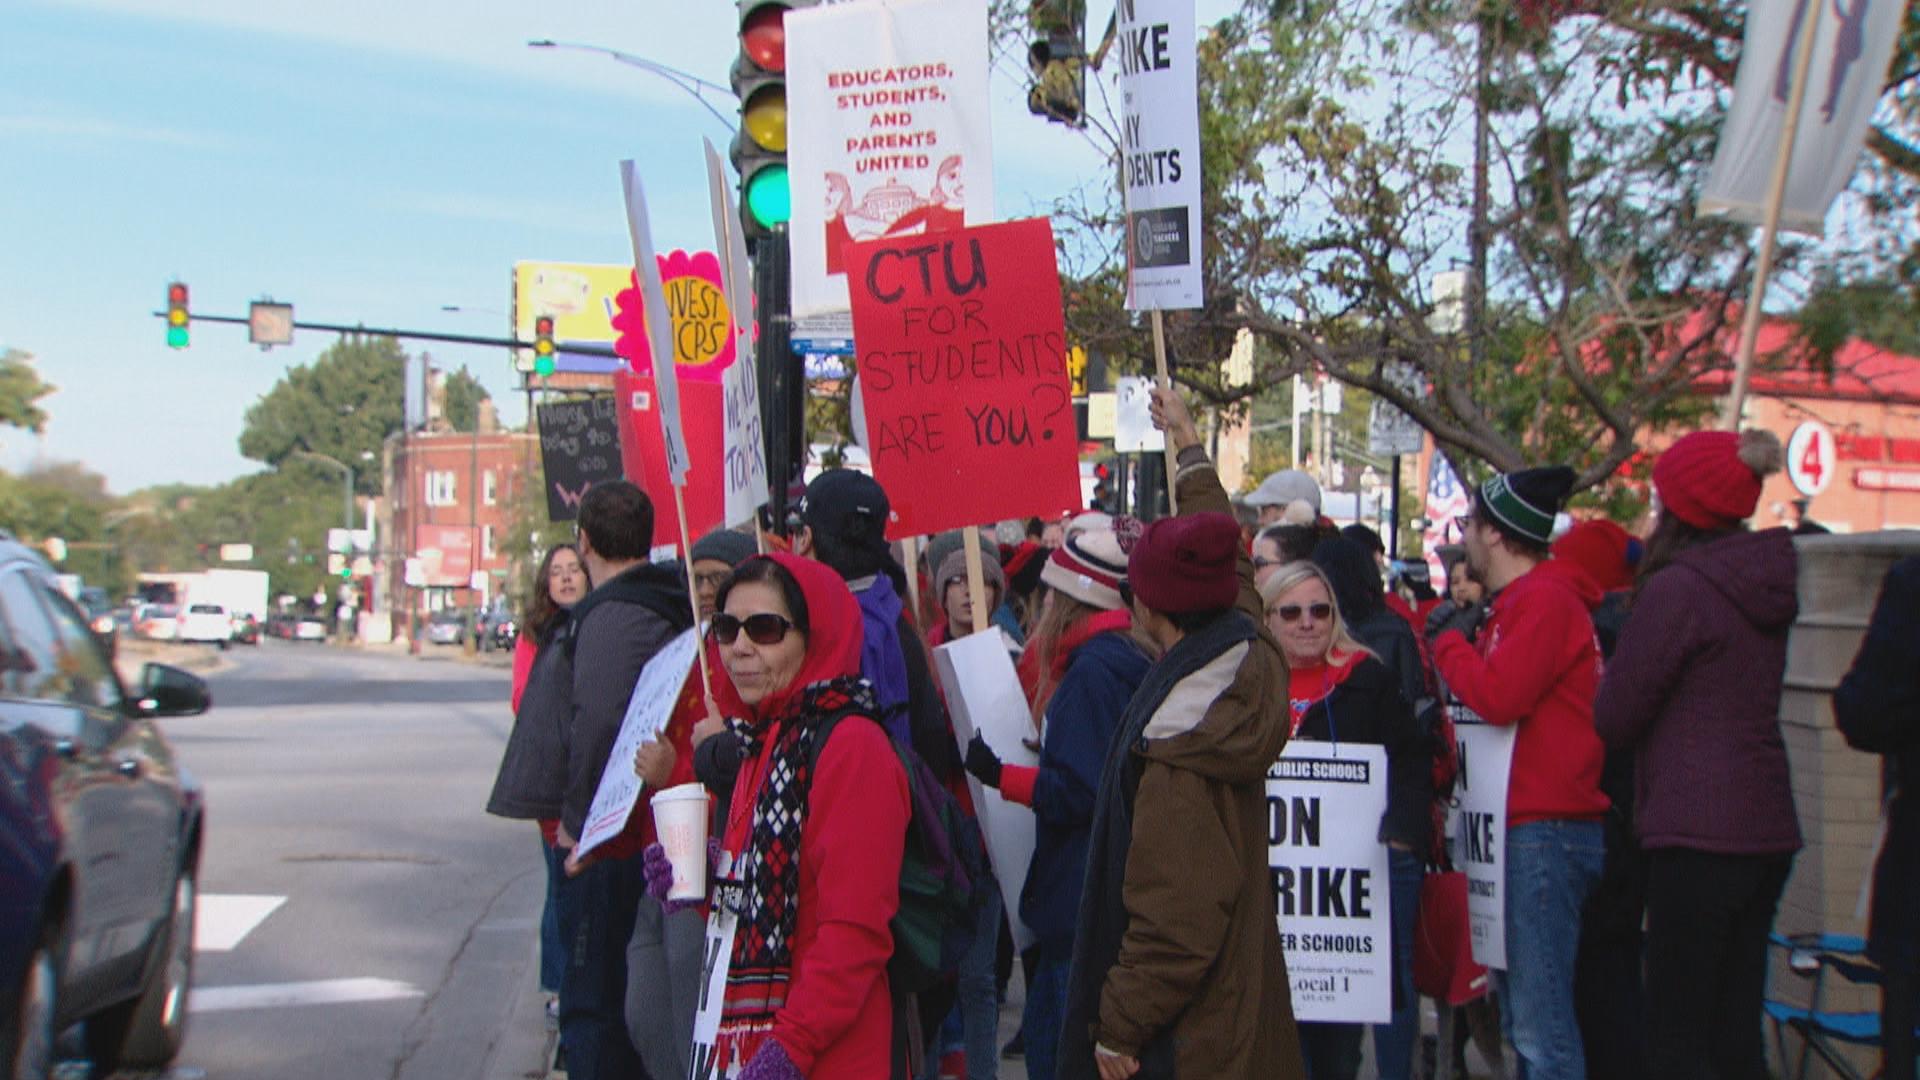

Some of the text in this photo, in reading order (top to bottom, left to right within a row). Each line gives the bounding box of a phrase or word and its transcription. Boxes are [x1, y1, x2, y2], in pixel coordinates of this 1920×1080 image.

[827, 63, 953, 89] EDUCATORS,
[837, 86, 946, 109] STUDENTS,
[870, 112, 912, 128] AND
[846, 130, 937, 153] PARENTS
[856, 154, 930, 174] UNITED
[865, 238, 988, 305] CTU
[904, 299, 988, 338] FOR
[865, 331, 1064, 392] STUDENTS
[877, 383, 1066, 464] ARE YOU?
[1800, 431, 1823, 487] 4
[1312, 763, 1367, 782] SCHOOLS
[1301, 934, 1374, 954] SCHOOLS
